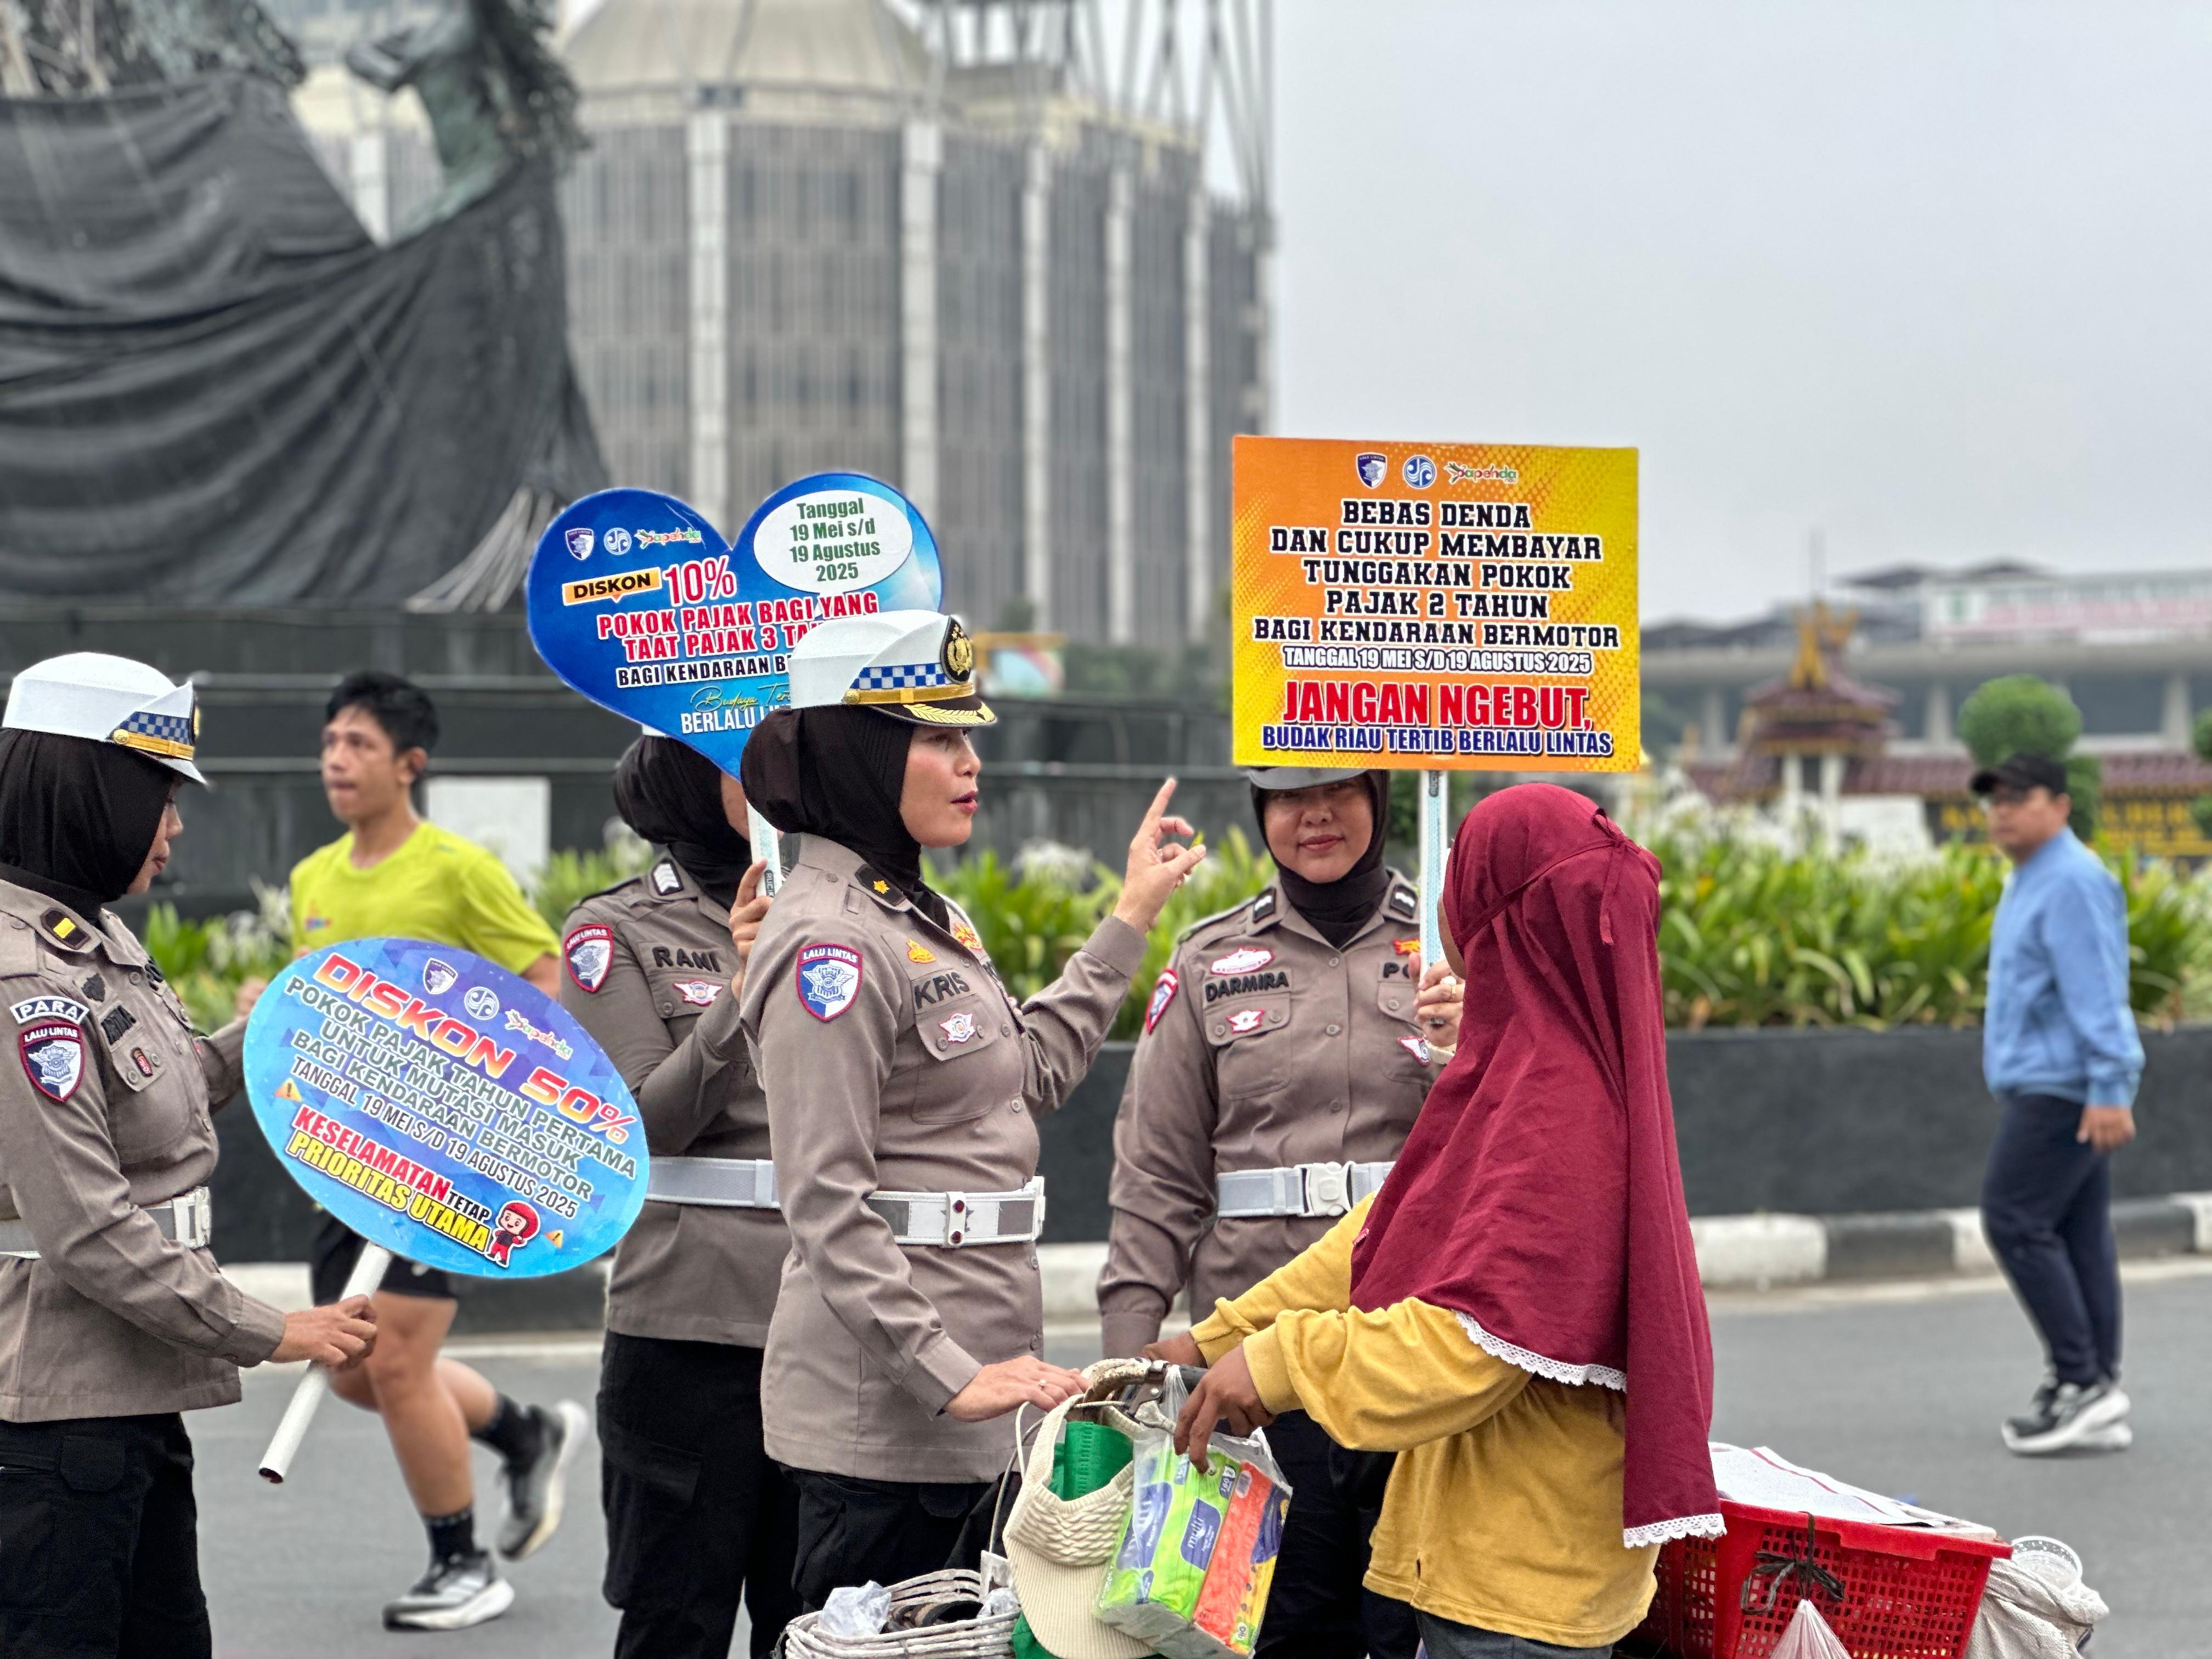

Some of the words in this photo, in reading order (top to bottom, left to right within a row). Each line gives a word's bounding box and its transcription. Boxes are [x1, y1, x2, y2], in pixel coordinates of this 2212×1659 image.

[797, 498, 864, 519] Tanggal
[1343, 500, 1430, 526] BEBAS
[1441, 504, 1531, 528] DENDA
[790, 524, 809, 541] 19
[812, 521, 843, 539] Mei
[847, 518, 876, 536] s/d
[789, 545, 809, 562] 19
[813, 541, 881, 561] Agustus
[1272, 529, 1327, 553] DAN
[1338, 532, 1429, 556] CUKUP
[1441, 535, 1601, 560] MEMBAYAR
[573, 573, 652, 599] DISKON
[664, 557, 736, 606] 10%
[816, 562, 859, 582] 2025
[1304, 560, 1471, 586] TUNGGAKAN
[1481, 564, 1571, 588] POKOK
[599, 612, 675, 639] POKOK
[684, 606, 752, 633] PAJAK
[759, 599, 813, 623] BAGI
[820, 592, 878, 617] YANG
[1327, 590, 1419, 615] PAJAK
[1429, 593, 1444, 616] 2
[1455, 595, 1548, 618] TAHUN
[626, 637, 678, 662] TAAT
[686, 631, 756, 657] PAJAK
[762, 627, 777, 648] 3
[1254, 619, 1311, 640] BAGI
[1321, 622, 1474, 645] KENDARAAN
[1484, 625, 1618, 648] BERMOTOR
[618, 665, 661, 687] BAGI
[665, 657, 769, 684] KENDARAAN
[1285, 647, 1358, 668] TANGGAL
[1359, 648, 1378, 669] 19
[1382, 650, 1412, 669] MEI
[1414, 650, 1446, 670] S/D
[1448, 651, 1467, 670] 19
[1470, 651, 1545, 672] AGUSTUS
[1548, 653, 1591, 674] 2025
[690, 686, 758, 713] Budaya
[1284, 681, 1431, 724] JANGAN
[1440, 685, 1592, 730] NGEBUT,
[681, 707, 755, 734] BERLALU
[1263, 727, 1330, 749] BUDAK
[1335, 729, 1381, 750] RIAU
[1387, 730, 1454, 753] TERTIB
[1459, 731, 1543, 754] BERLALU
[1547, 732, 1612, 755] LINTAS
[566, 932, 582, 949] LALU
[582, 929, 607, 938] LINTAS
[652, 946, 720, 972] RANI
[803, 948, 825, 960] LALU
[828, 947, 857, 963] LINTAS
[914, 972, 970, 1009] KRIS
[1205, 971, 1289, 1002] DARMIRA
[20, 1001, 77, 1019] PARA
[24, 1029, 48, 1042] LALU
[49, 1028, 78, 1039] LINTAS
[314, 953, 517, 1078] DISKON
[520, 1066, 637, 1145] 50%
[285, 977, 374, 1034] POKOK
[372, 1023, 445, 1075] PAJAK
[452, 1063, 529, 1118] TAHUN
[535, 1110, 636, 1179] PERTAMA
[320, 1023, 403, 1078] UNTUK
[407, 1068, 494, 1130] MUTASI
[499, 1117, 580, 1170] MASUK
[293, 1030, 342, 1071] BAGI
[351, 1060, 475, 1137] KENDARAAN
[482, 1129, 593, 1199] BERMOTOR
[291, 1057, 357, 1105] TANGGAL
[363, 1094, 382, 1116] 19
[382, 1107, 414, 1133] MEI
[410, 1121, 445, 1150] S/D
[448, 1138, 467, 1160] 19
[467, 1150, 537, 1197] AGUSTUS
[535, 1189, 579, 1219] 2025
[293, 1107, 453, 1201] KESELAMATAN
[447, 1189, 490, 1222] TETAP
[287, 1132, 411, 1209] PRIORITAS
[409, 1194, 492, 1251] UTAMA
